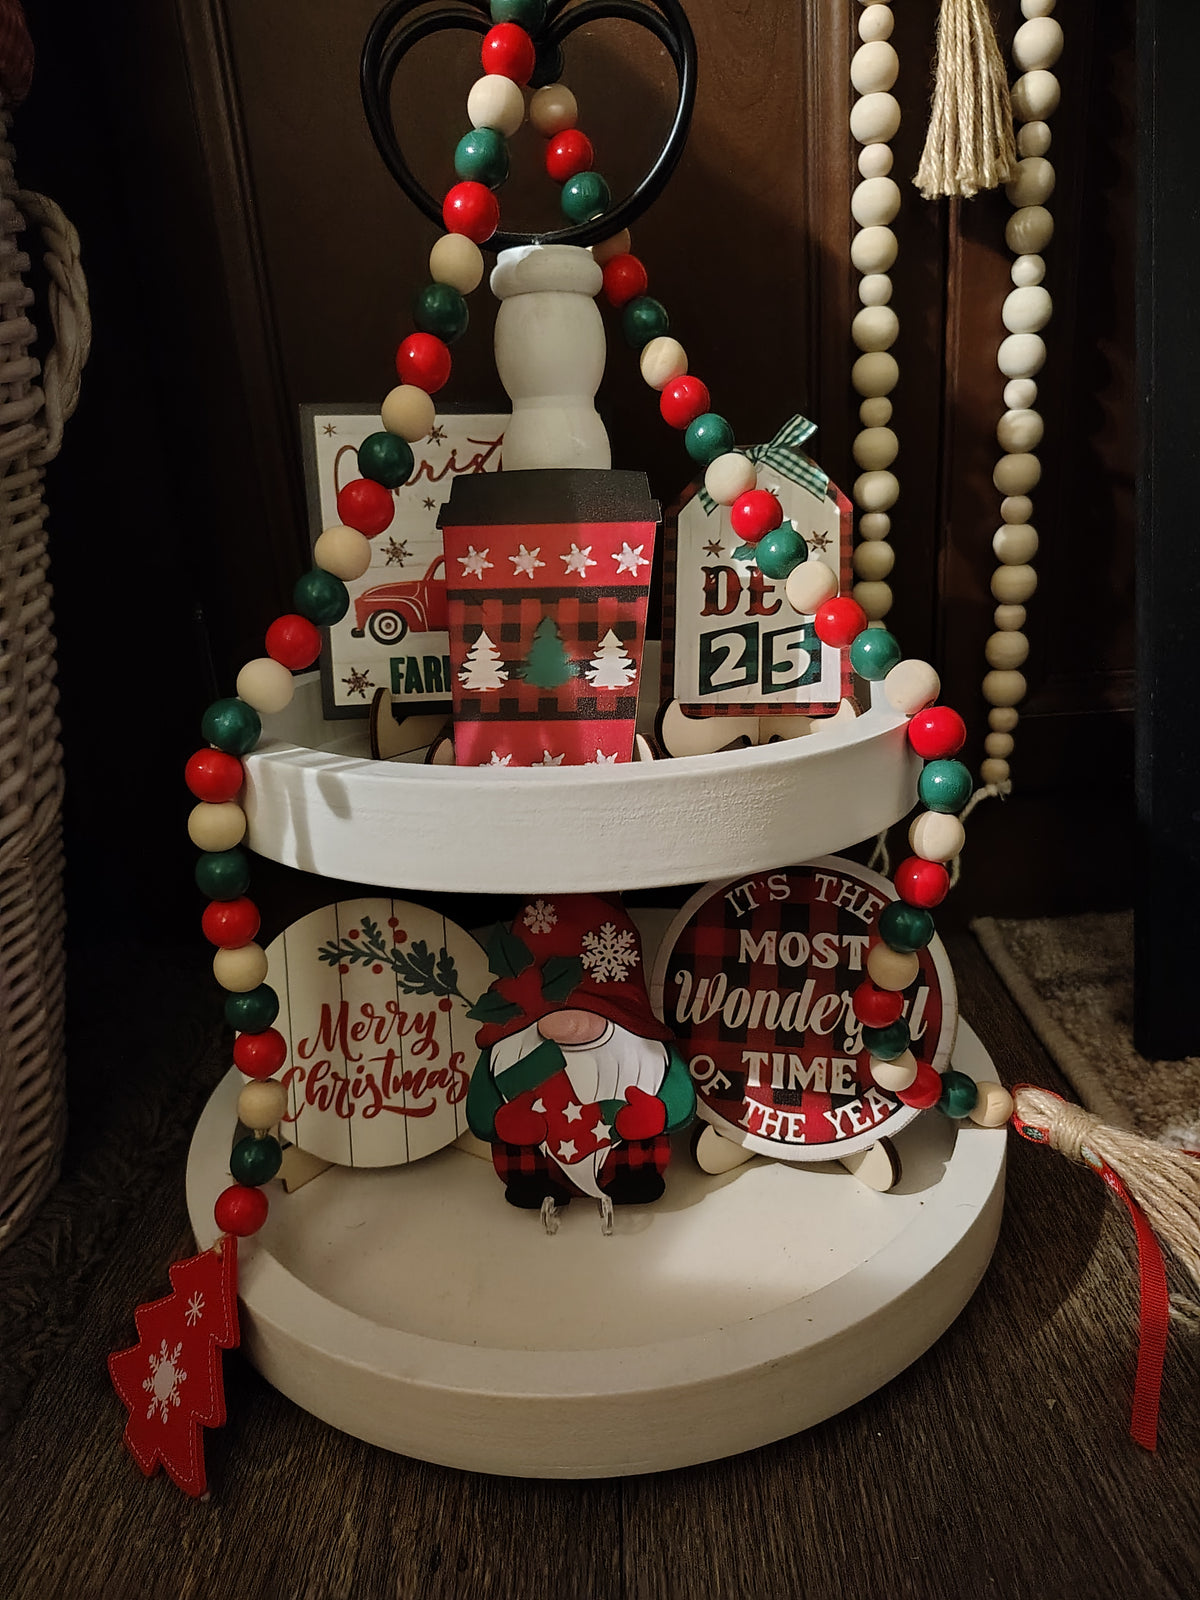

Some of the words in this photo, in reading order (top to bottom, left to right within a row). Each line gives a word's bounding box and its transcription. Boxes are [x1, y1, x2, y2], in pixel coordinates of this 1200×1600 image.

[700, 566, 812, 616] DE
[709, 629, 811, 687] 25
[724, 873, 791, 918] IT'S
[815, 873, 885, 925] THE
[737, 929, 870, 971] MOST
[297, 1001, 440, 1062] Merry
[674, 969, 930, 1055] Wonderl
[281, 1048, 470, 1122] Christmas
[689, 1054, 732, 1097] OF
[737, 1096, 806, 1143] THE
[823, 1086, 897, 1139] YEA
[742, 1051, 857, 1095] TIME
